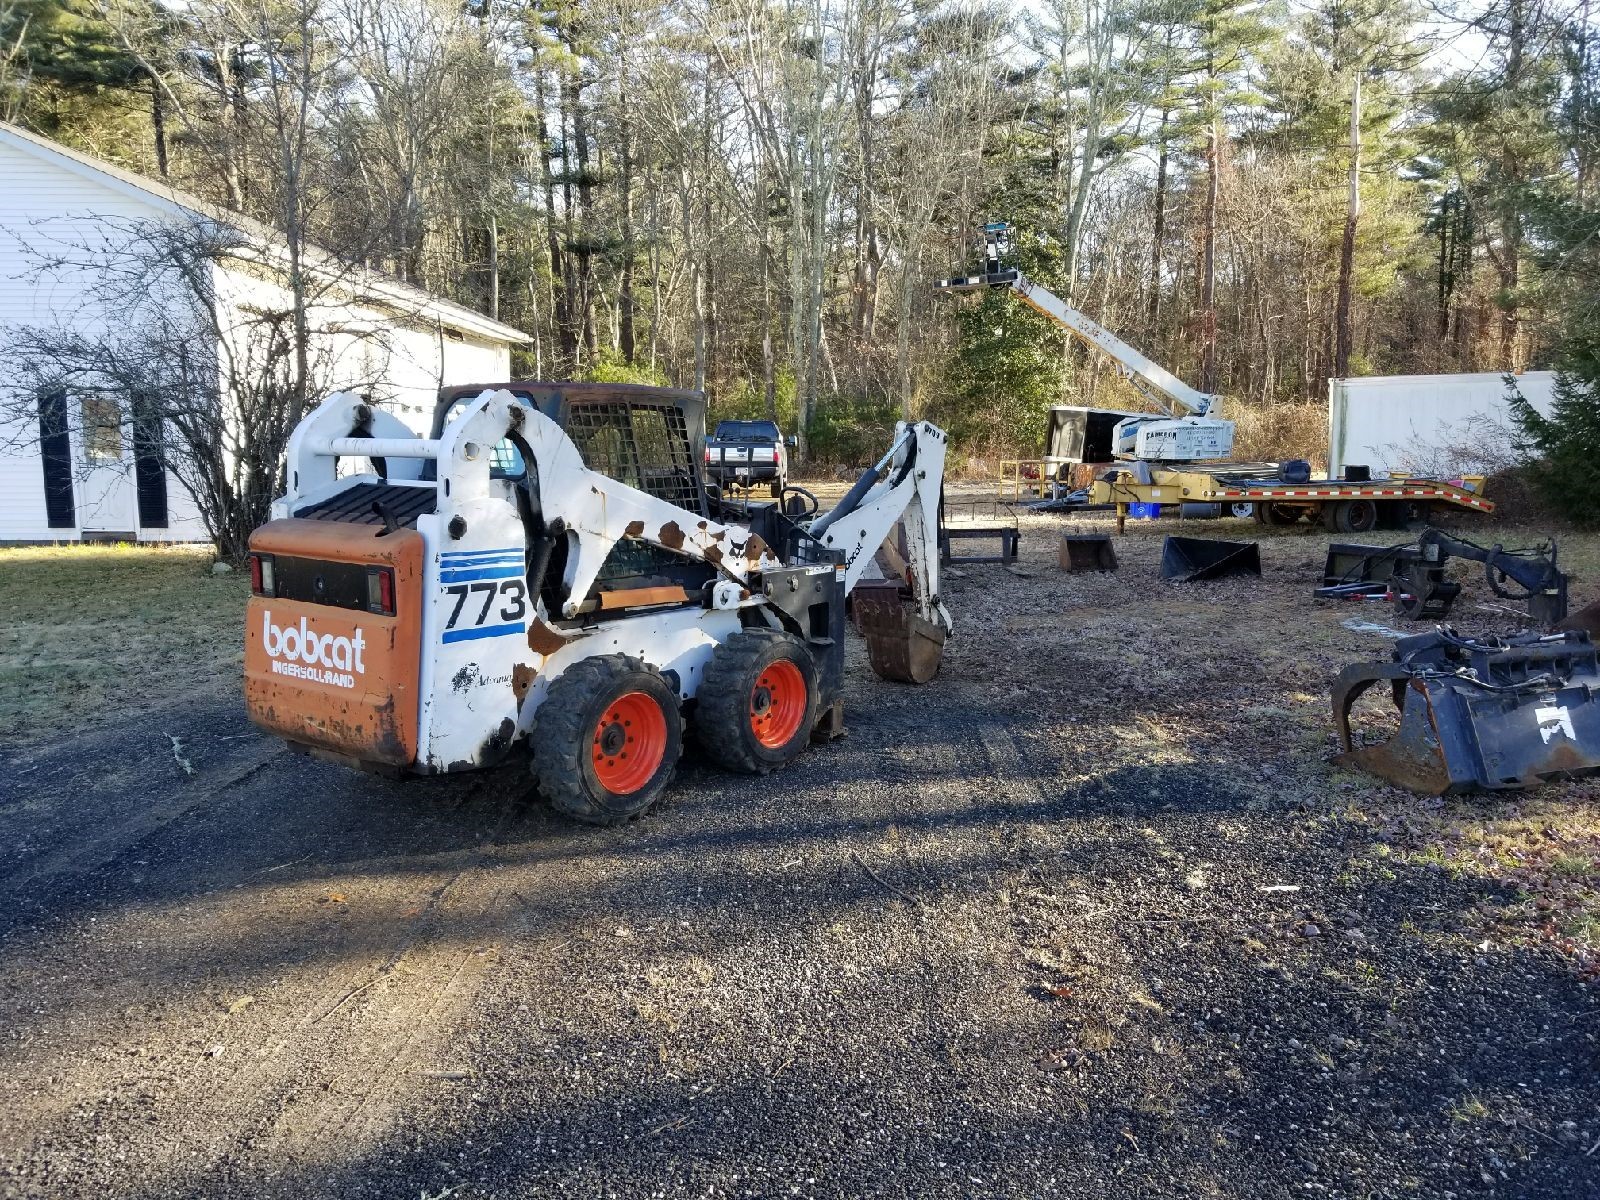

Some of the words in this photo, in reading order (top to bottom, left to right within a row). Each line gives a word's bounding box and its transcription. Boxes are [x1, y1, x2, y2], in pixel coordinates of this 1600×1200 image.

[845, 541, 863, 571] obcat
[443, 579, 526, 629] 773
[263, 610, 366, 674] bobcat
